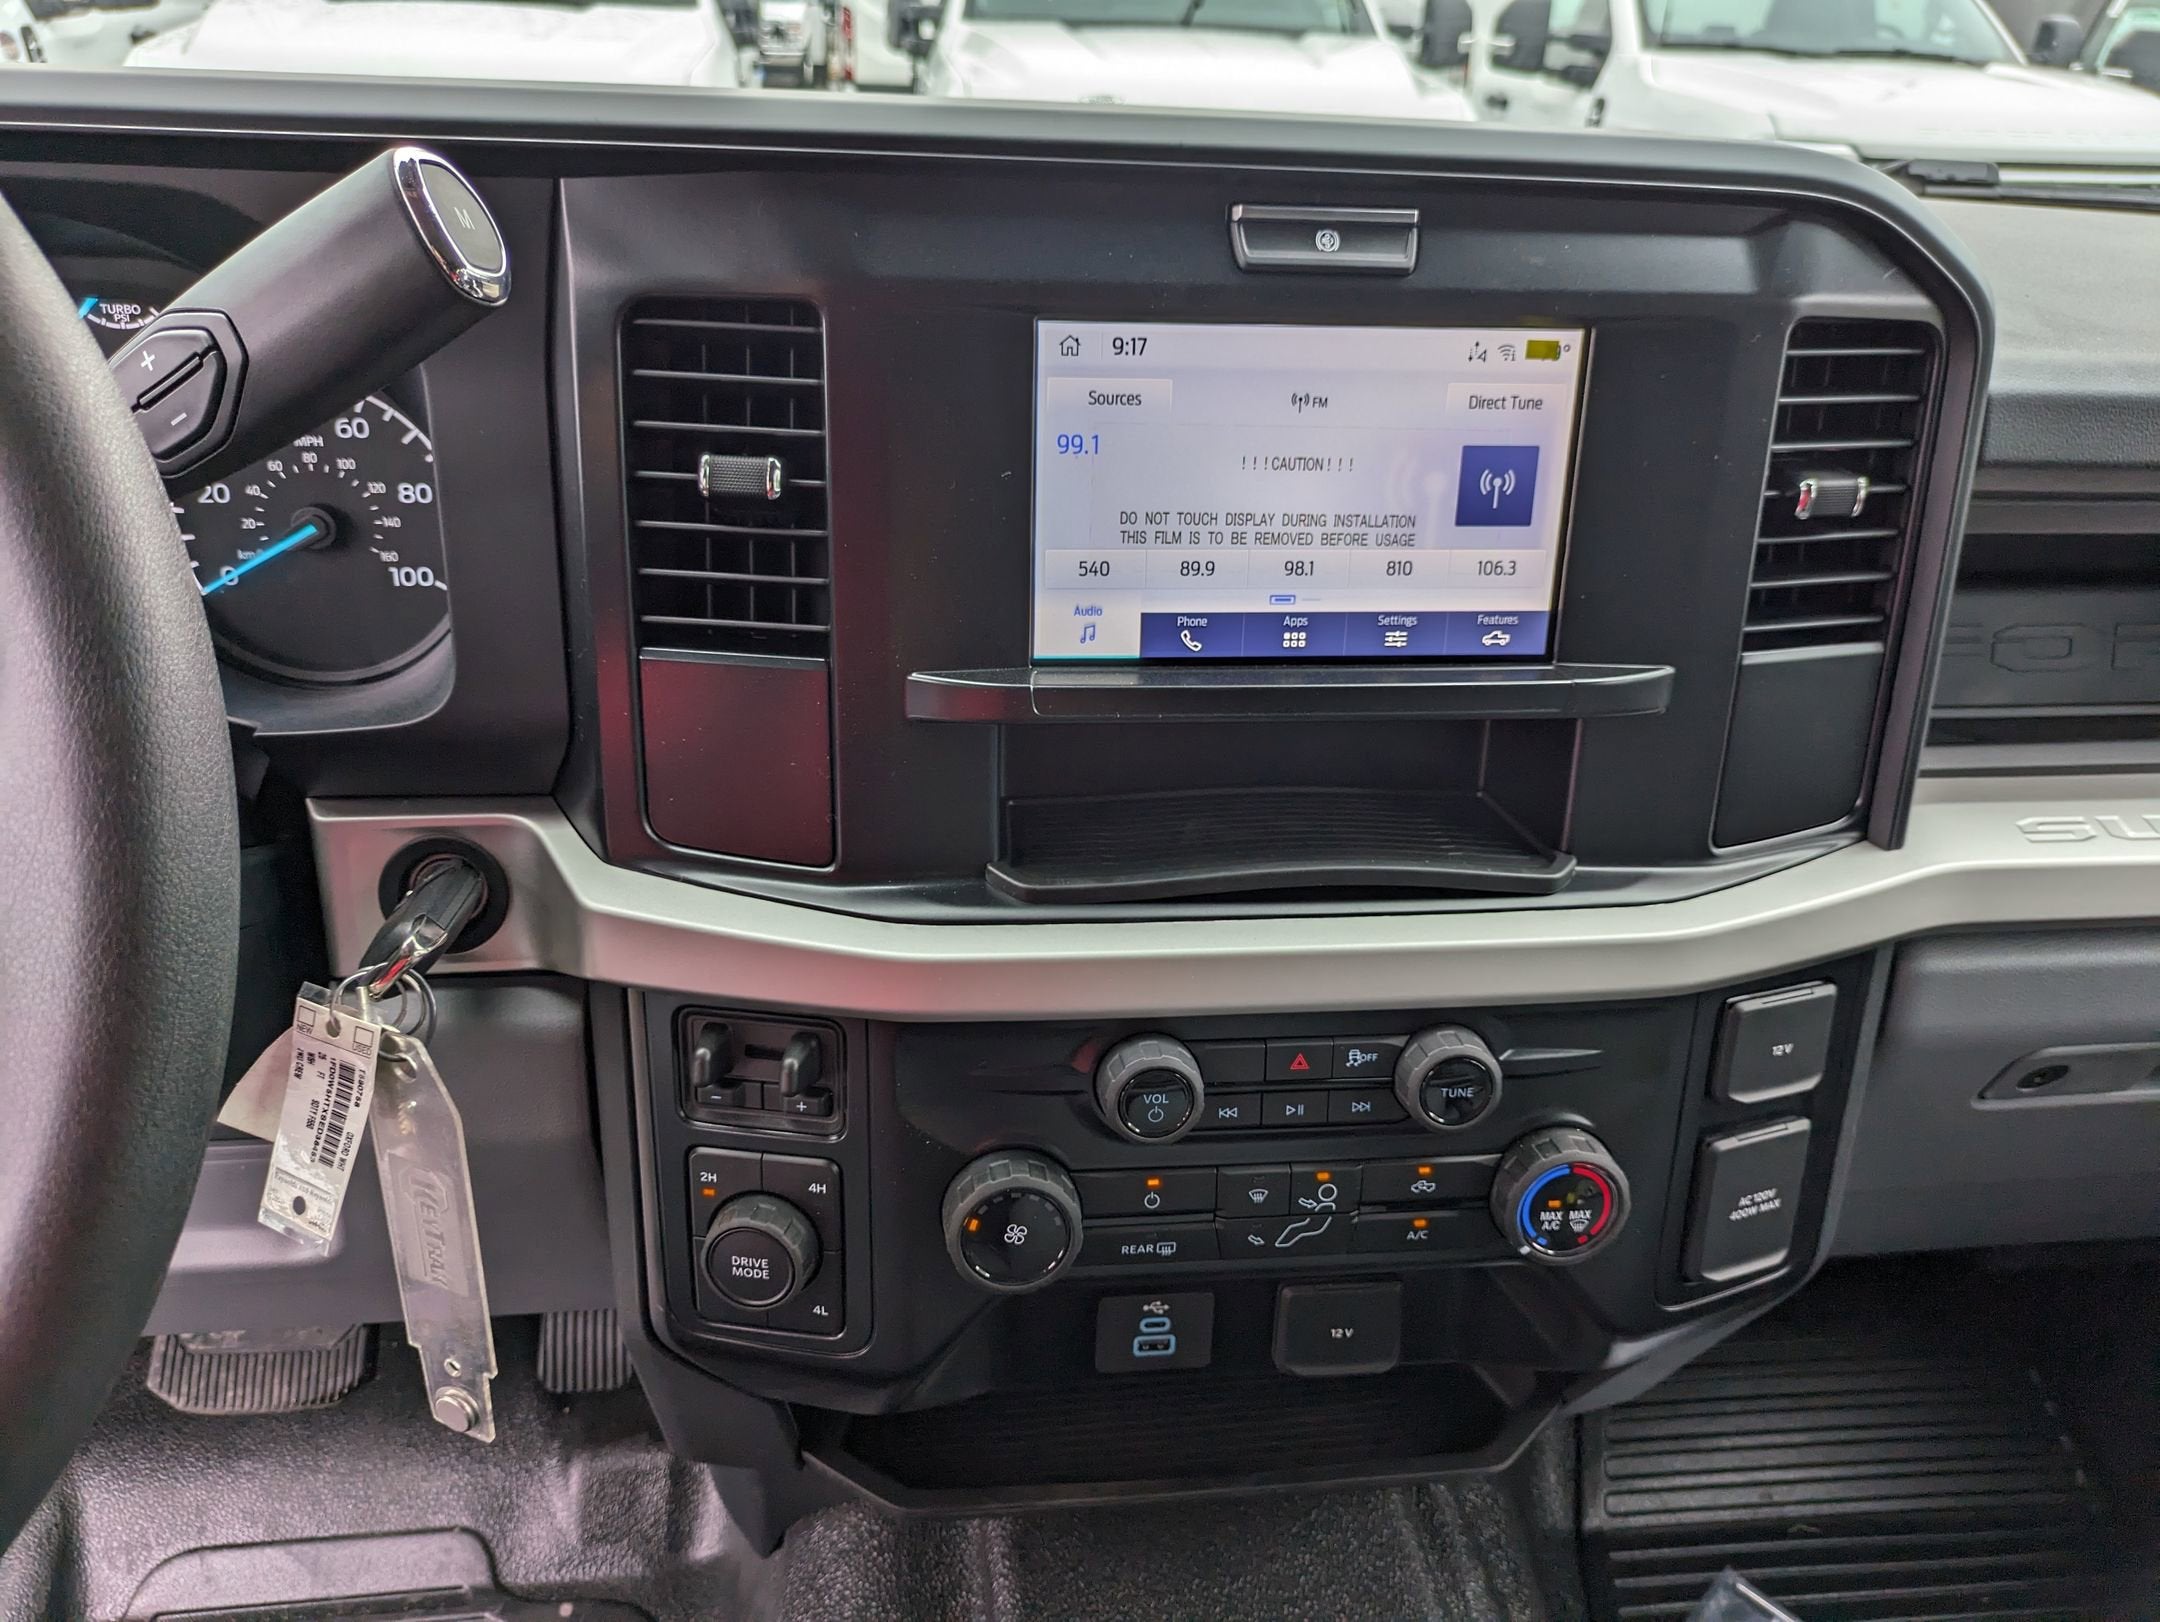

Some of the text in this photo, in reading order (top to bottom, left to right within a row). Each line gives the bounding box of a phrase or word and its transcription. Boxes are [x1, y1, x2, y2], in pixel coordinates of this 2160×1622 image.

[453, 206, 475, 230] M
[100, 303, 141, 315] TURBO
[113, 314, 130, 322] PSI
[1112, 337, 1147, 356] 9:17
[1088, 390, 1142, 406] Sources
[1312, 397, 1328, 409] FM
[1469, 395, 1543, 411] Direct Tune
[334, 417, 370, 439] 60
[293, 434, 324, 447] MPH
[1057, 434, 1099, 455] 99.1
[302, 451, 318, 464] 80
[267, 460, 283, 473] 60
[336, 458, 356, 471] 100
[198, 483, 230, 503] 20
[246, 485, 261, 496] 40
[368, 482, 386, 494] 120
[398, 482, 433, 504] 80
[241, 518, 257, 530] 20
[382, 516, 402, 528] 140
[1119, 511, 1417, 529] DO NOT TOUCH DISPLAY DURING INSTALLATION
[1120, 530, 1417, 548] THIS FILM IS TO BE REMOVED BEFORE USAGE
[1078, 560, 1110, 577] 540
[1180, 560, 1216, 577] 89.9
[1284, 560, 1315, 577] 98.1
[1386, 560, 1413, 577] 810
[1477, 560, 1516, 577] 106.3
[219, 565, 240, 587] 0
[388, 566, 434, 588] 100
[1073, 604, 1103, 618] Audio
[1177, 615, 1208, 628] Phone
[1283, 615, 1308, 629] Apps
[1377, 614, 1418, 628] Settings
[1477, 614, 1519, 626] Features
[1358, 1051, 1378, 1063] OFF
[1143, 1094, 1169, 1105] VOL
[1441, 1086, 1475, 1100] TUNE
[700, 1171, 718, 1184] 2H
[808, 1182, 827, 1195] 4H
[1759, 1198, 1782, 1212] MAX
[1540, 1211, 1564, 1221] MAX
[1568, 1209, 1592, 1220] MAX
[1541, 1221, 1561, 1231] A/C
[1406, 1229, 1429, 1241] A/C
[1121, 1243, 1154, 1256] REAR
[732, 1256, 769, 1268] DRIVE
[732, 1267, 770, 1279] MODE
[813, 1304, 829, 1317] 4L
